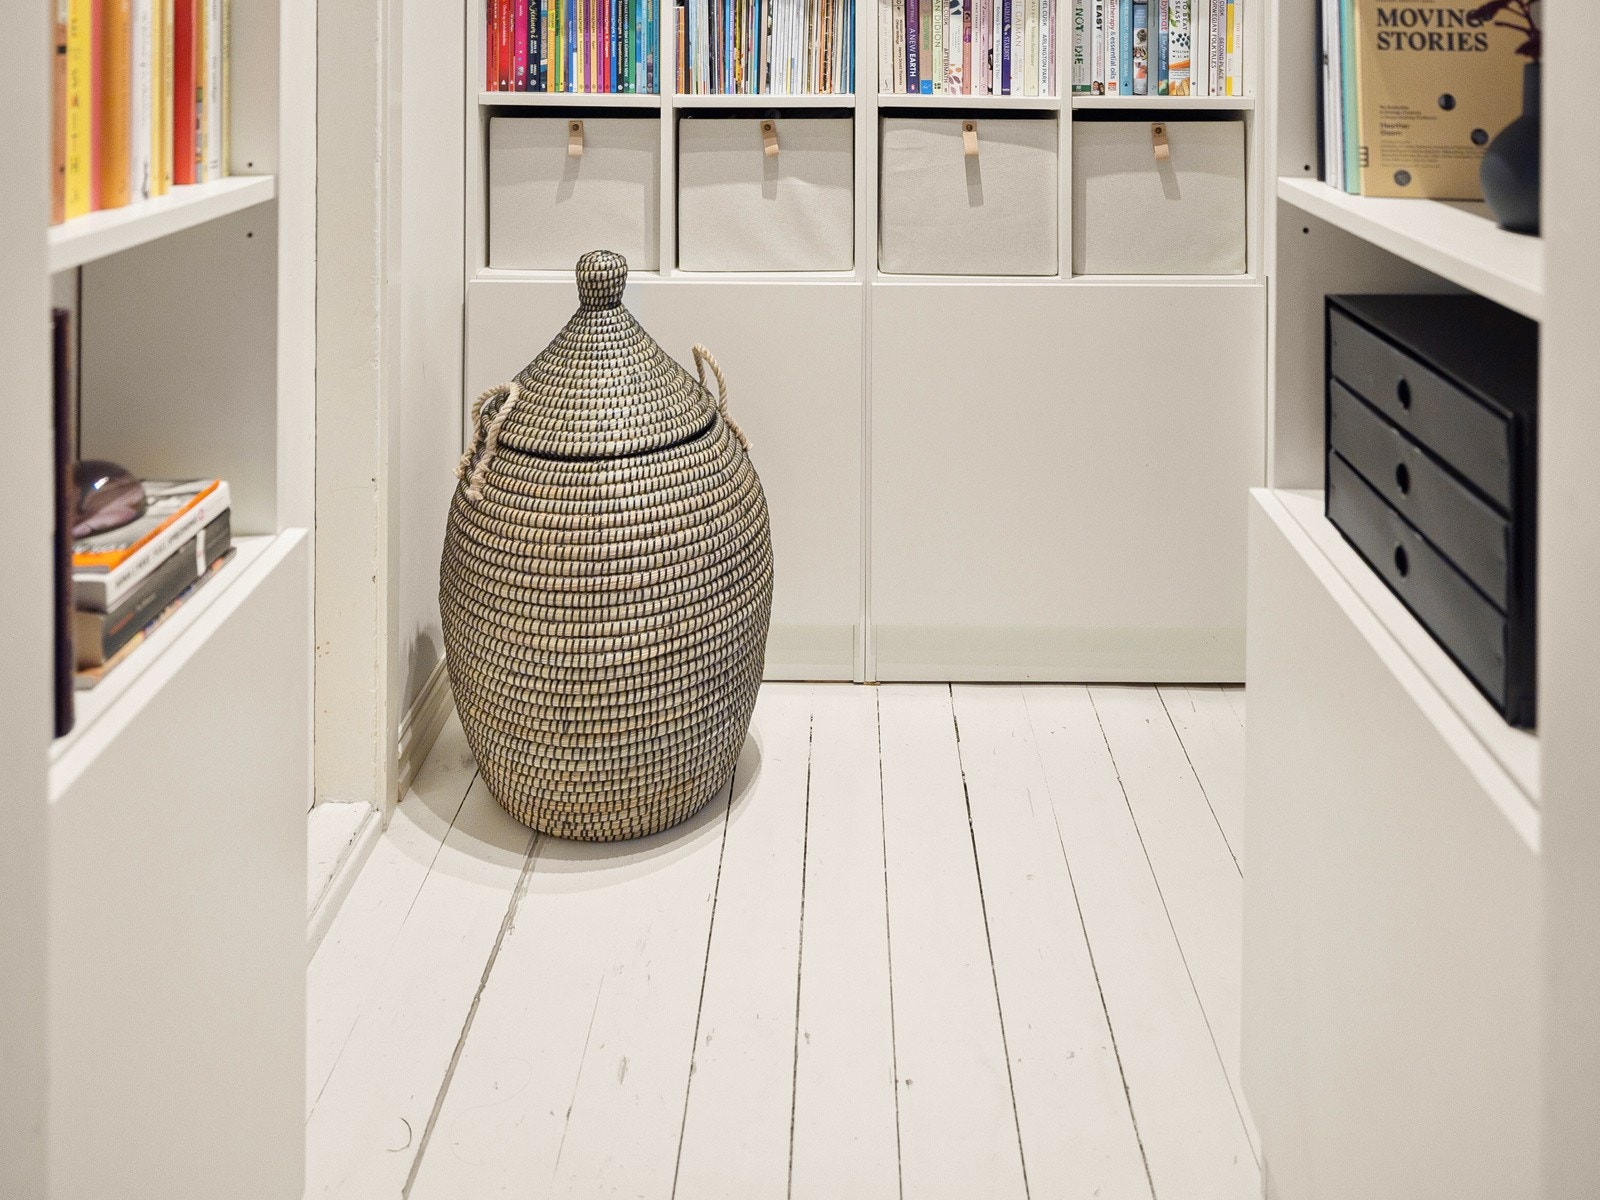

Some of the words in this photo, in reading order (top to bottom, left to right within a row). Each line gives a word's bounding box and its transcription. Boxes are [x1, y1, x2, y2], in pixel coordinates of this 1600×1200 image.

[1182, 1, 1188, 10] TO
[1076, 8, 1084, 32] NOT
[1377, 32, 1488, 52] STORIES
[1075, 45, 1084, 64] DIE
